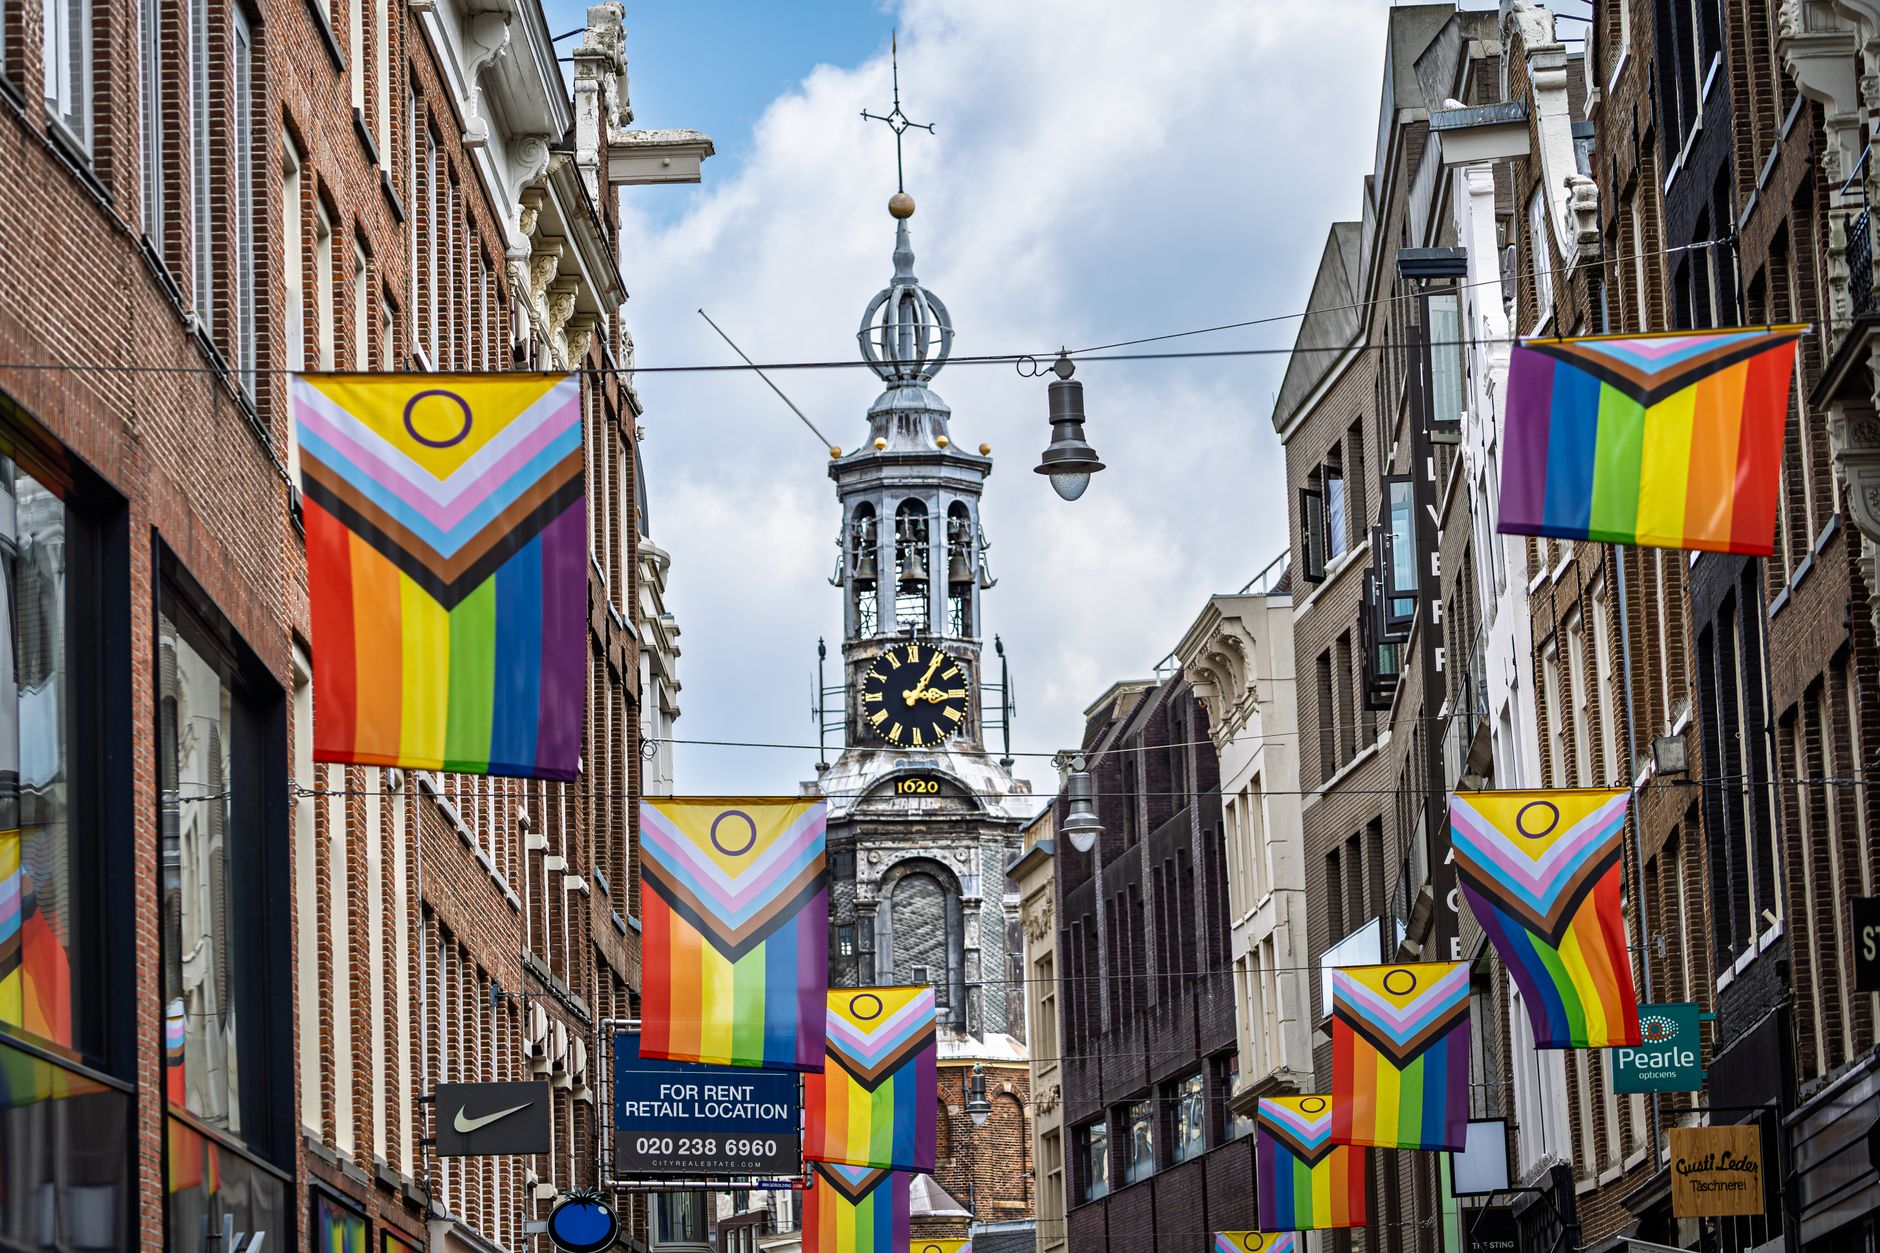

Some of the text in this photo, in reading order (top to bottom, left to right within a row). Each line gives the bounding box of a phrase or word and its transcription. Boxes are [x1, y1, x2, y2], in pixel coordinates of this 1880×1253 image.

[897, 778, 939, 794] 1620
[1618, 1046, 1694, 1069] Pearle
[1639, 1071, 1676, 1080] opticiens
[660, 1084, 754, 1101] FOR RENT
[625, 1101, 788, 1119] RETAIL LOCATION
[636, 1137, 777, 1157] 020 238 6960
[652, 1160, 761, 1168] CITYREALESTATE.COM
[1676, 1151, 1758, 1176] Gusti Leder
[1690, 1179, 1747, 1192] Täschnerei
[1489, 1241, 1514, 1249] STING
